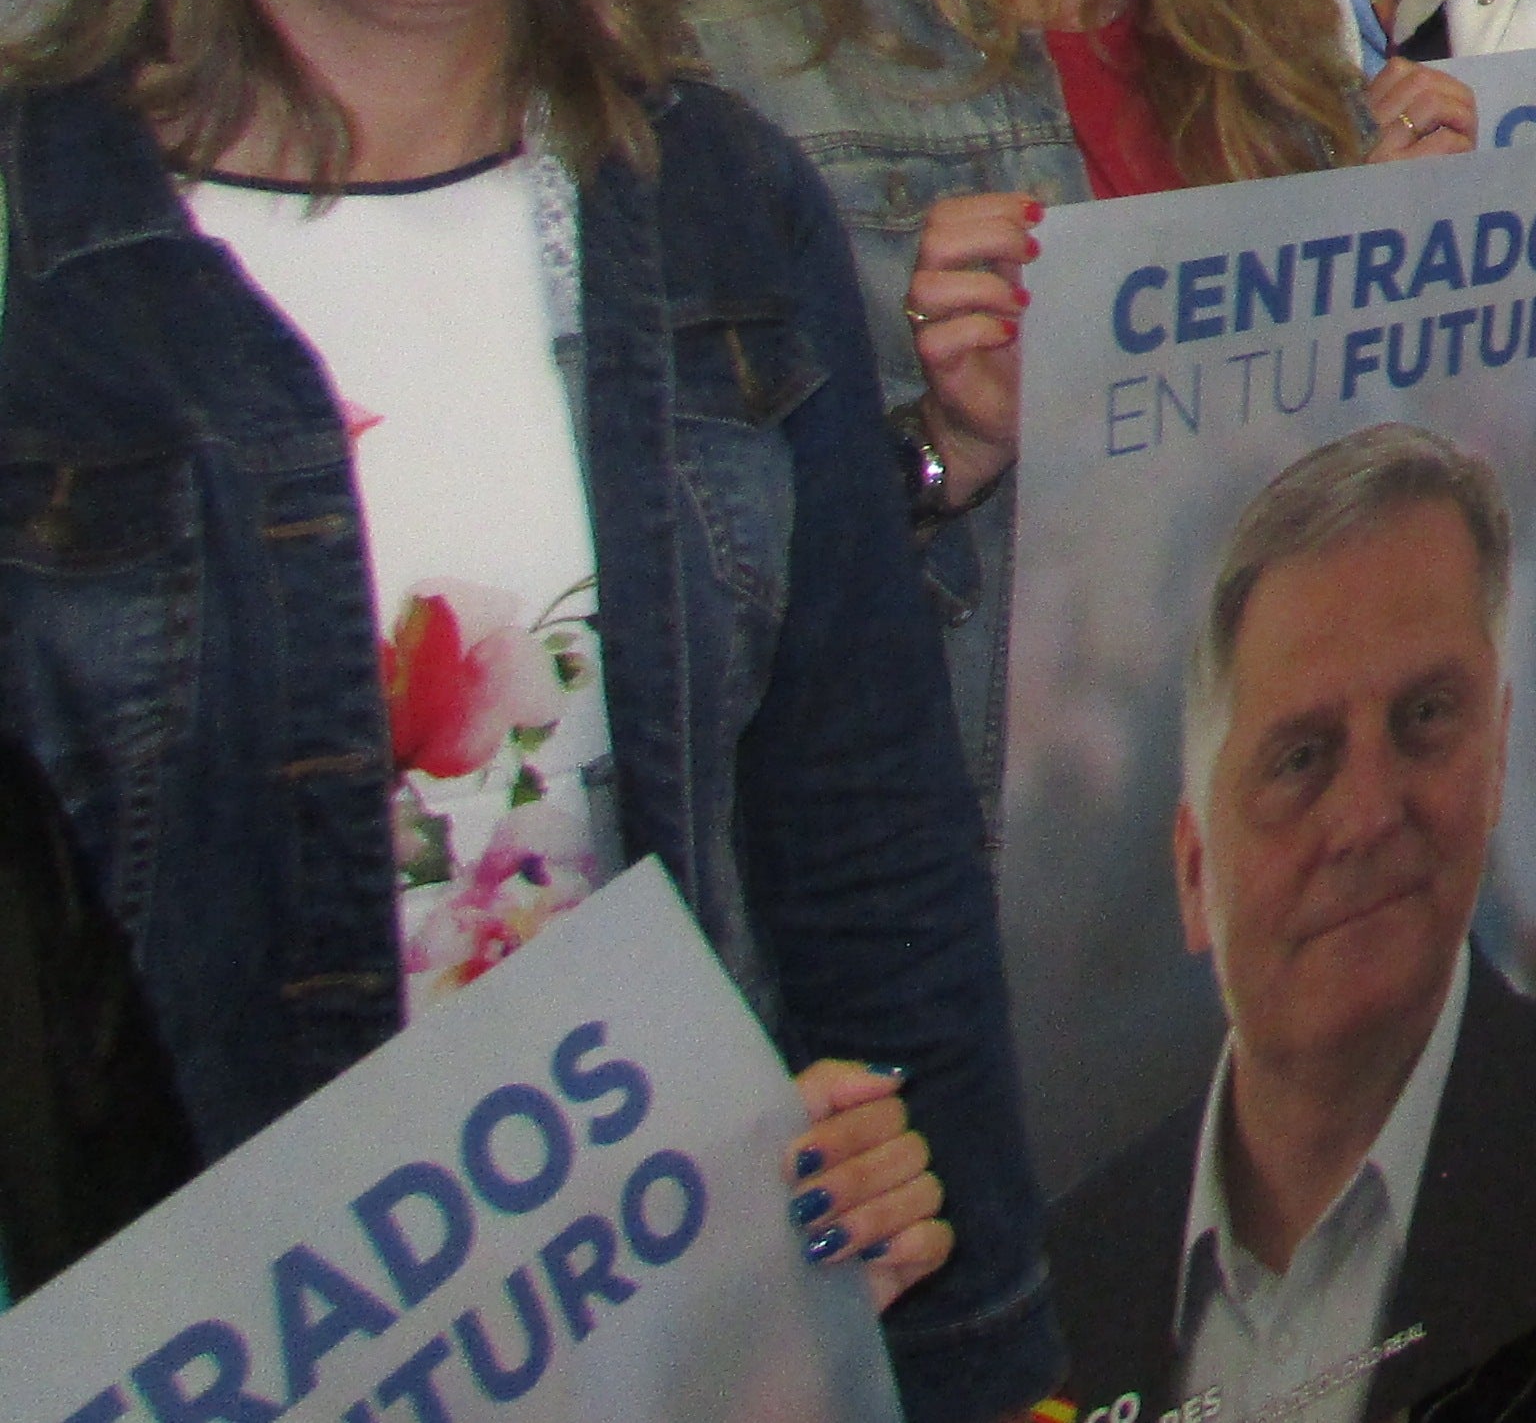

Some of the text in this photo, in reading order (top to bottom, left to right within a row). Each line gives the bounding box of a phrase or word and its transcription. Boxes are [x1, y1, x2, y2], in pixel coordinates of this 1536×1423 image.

[1106, 377, 1200, 458] EN
[1225, 339, 1320, 426] TU
[340, 1149, 708, 1423] TURO
